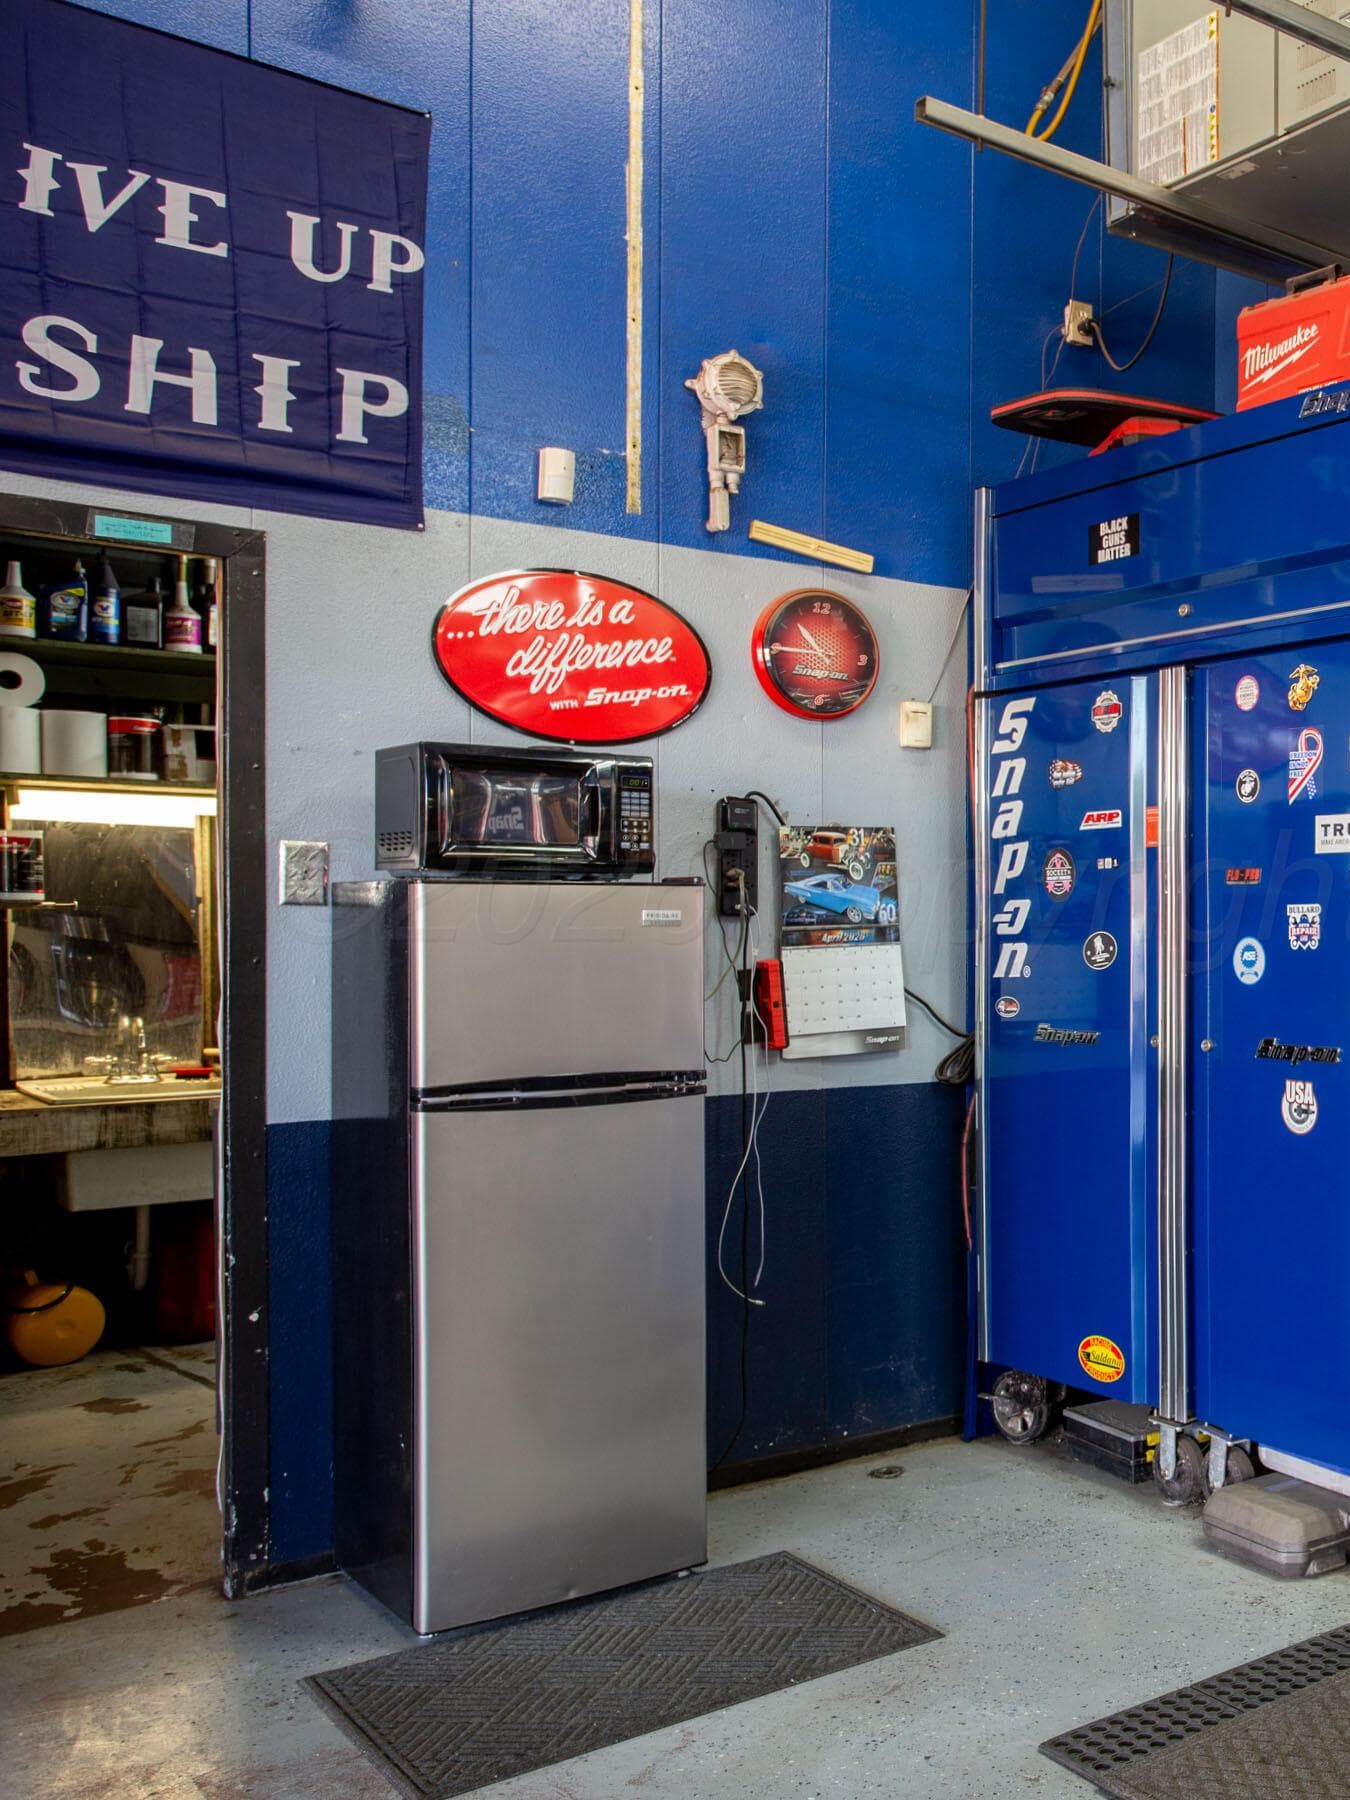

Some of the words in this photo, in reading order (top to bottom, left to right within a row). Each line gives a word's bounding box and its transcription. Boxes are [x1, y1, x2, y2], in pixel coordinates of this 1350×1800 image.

[285, 209, 426, 294] UP
[1240, 323, 1320, 380] Milwaukee
[14, 314, 410, 445] SHIP
[1099, 515, 1129, 537] BLACK
[1102, 531, 1126, 549] GUNS
[1097, 543, 1131, 564] MATTER
[566, 593, 603, 629] is
[608, 598, 636, 625] a
[812, 602, 832, 615] 12
[505, 633, 674, 695] difference
[857, 654, 868, 666] 3
[792, 663, 849, 681] Snap-on
[549, 699, 579, 711] WITH
[583, 684, 690, 707] Snap-on
[814, 694, 825, 706] 6
[1084, 811, 1120, 825] ARP
[849, 828, 865, 847] 31
[1288, 905, 1320, 914] BULLARD
[1242, 950, 1256, 961] ASE
[1034, 1023, 1099, 1047] Snap-on
[1254, 1038, 1342, 1066] Snap-on
[1285, 1079, 1314, 1105] USA
[1090, 1352, 1121, 1367] Saldana
